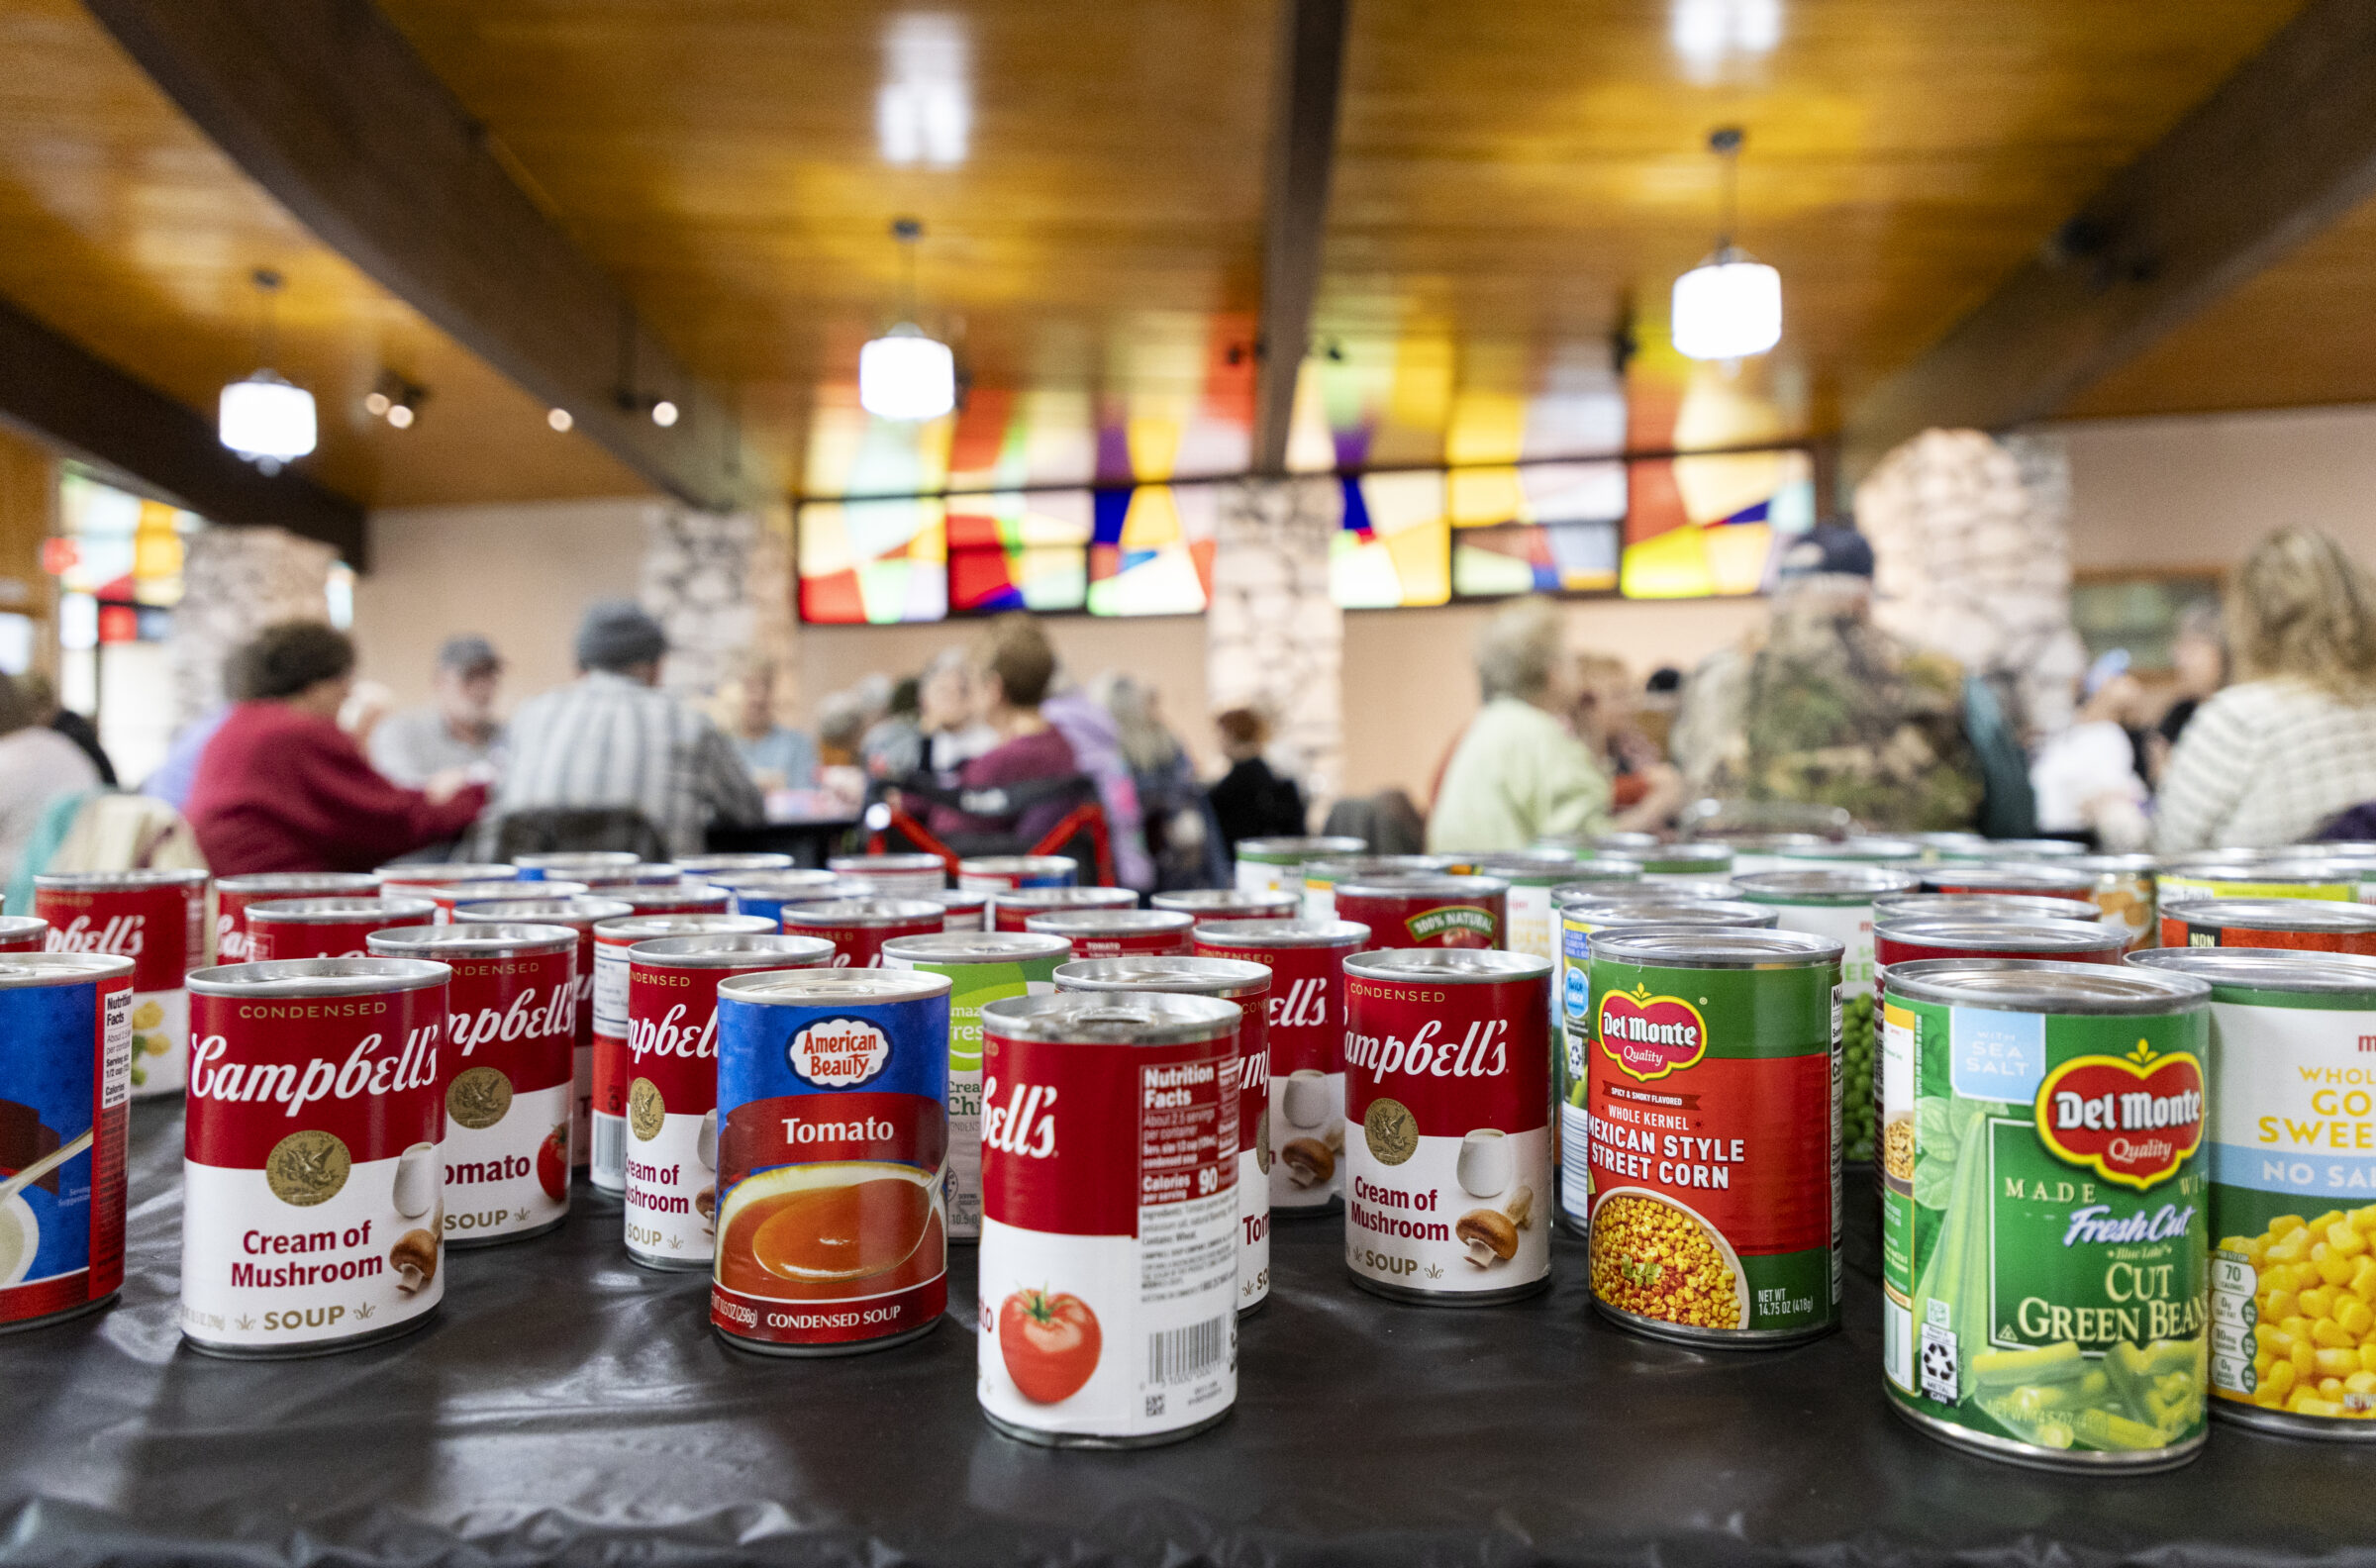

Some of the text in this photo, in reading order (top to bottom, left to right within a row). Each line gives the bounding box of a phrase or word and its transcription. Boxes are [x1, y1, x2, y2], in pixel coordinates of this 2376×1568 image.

[1445, 912, 1492, 932] NATURAL
[107, 994, 132, 1010] Nutrition
[1350, 982, 1445, 1003] CONDENSED
[107, 1012, 125, 1027] Facts
[240, 1002, 387, 1019] CONDENSED
[803, 1030, 877, 1054] American
[1603, 1011, 1698, 1047] Del Monte
[1977, 1031, 2016, 1041] WITH
[1344, 1015, 1508, 1084] ampbell's
[1624, 1045, 1663, 1067] Quality
[1972, 1040, 2024, 1059] SEA
[191, 1025, 439, 1118] Campbell's
[811, 1053, 870, 1079] Beauty
[1144, 1064, 1215, 1088] Nutrition
[1966, 1056, 2030, 1077] SALT
[1144, 1088, 1192, 1109] Facts
[1611, 1087, 1682, 1106] SPICY & SMOKY FLAVORED
[2055, 1089, 2201, 1130] Del Monte
[2312, 1089, 2372, 1117] GO
[781, 1116, 894, 1144] Tomato
[1608, 1104, 1689, 1130] WHOLE KERNEL
[1588, 1113, 1744, 1162] MEXICAN STYLE
[2258, 1116, 2374, 1148] SWEE
[2109, 1137, 2171, 1163] Quality
[660, 1164, 680, 1185] of
[1592, 1141, 1729, 1189] STREET CORN
[2263, 1160, 2315, 1186] NO
[1143, 1167, 1218, 1195] Calories 90
[1355, 1175, 1437, 1212] Cream of
[2005, 1176, 2097, 1204] MADE
[444, 1210, 508, 1230] SOUP
[1351, 1200, 1449, 1241] Mushroom
[243, 1220, 371, 1254] Cream of
[628, 1223, 662, 1246] SOUP
[231, 1254, 383, 1288] Mushroom
[1365, 1249, 1418, 1276] SOUP
[2226, 1264, 2241, 1282] 70
[1758, 1288, 1786, 1303] NET WT
[2105, 1262, 2174, 1303] CUT
[264, 1306, 345, 1330] SOUP
[767, 1305, 901, 1328] CONDENSED SOUP
[1759, 1295, 1813, 1316] 14.75 OZ (418g)
[2018, 1297, 2140, 1342] GREEN
